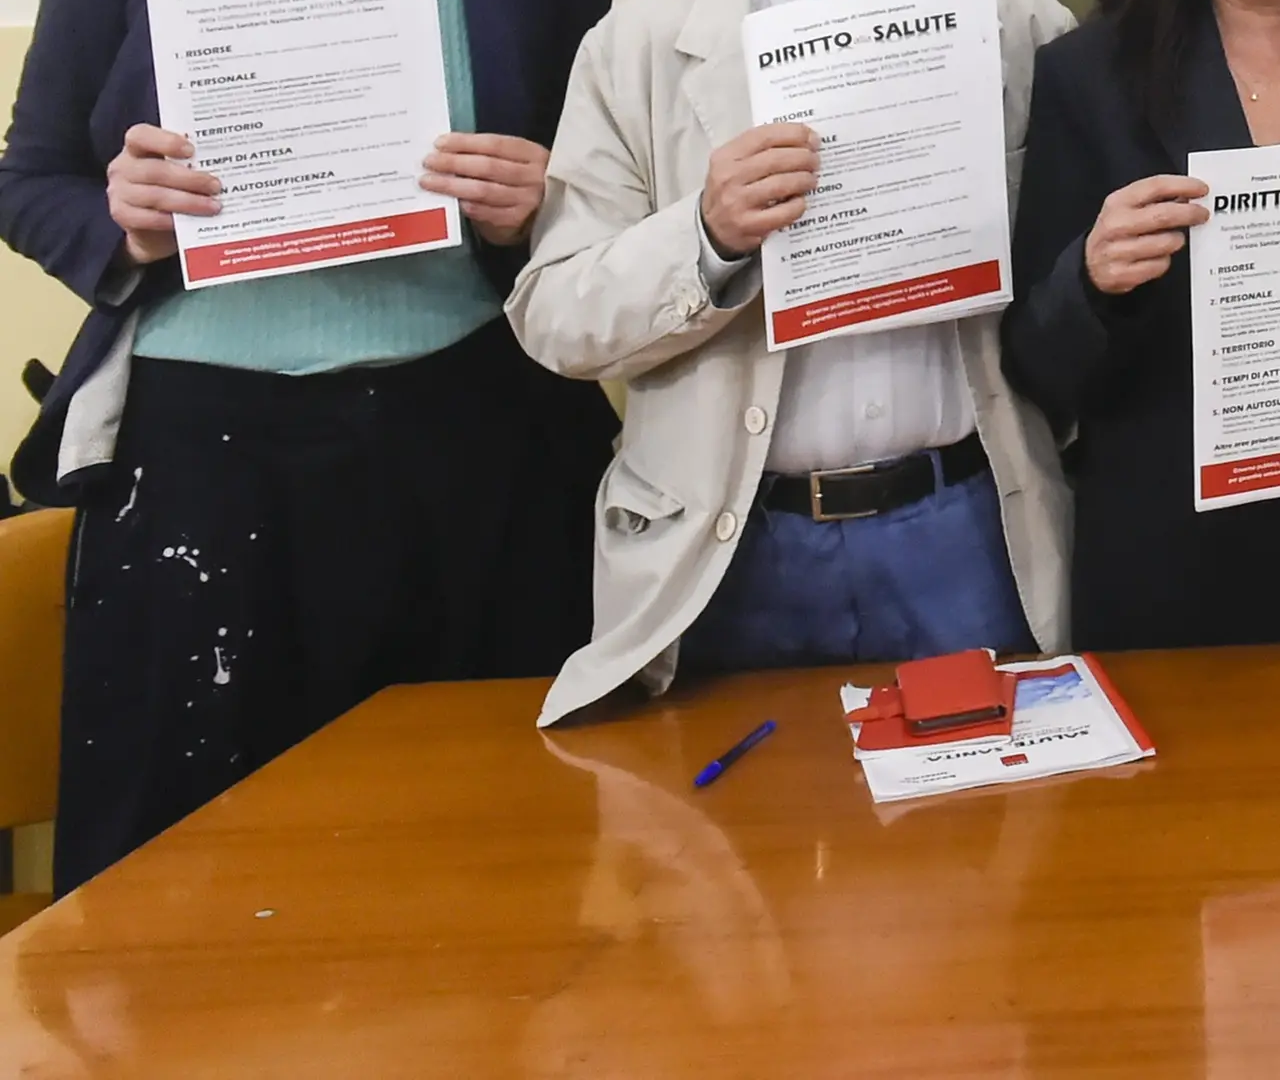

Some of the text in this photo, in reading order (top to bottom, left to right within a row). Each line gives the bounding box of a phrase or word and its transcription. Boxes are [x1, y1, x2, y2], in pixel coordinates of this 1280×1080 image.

[759, 12, 958, 69] DIRITTO SALUTE
[186, 45, 232, 58] RISORSE
[189, 72, 256, 88] PERSONALE
[194, 121, 264, 138] TERRITORIO
[199, 156, 232, 169] TEMPI
[236, 154, 247, 164] DI
[250, 148, 293, 162] ATTESA
[231, 170, 335, 192] AUTOSUFFICIENZA
[819, 213, 829, 223] DI
[831, 205, 868, 221] ATTESA
[790, 248, 813, 261] NON
[815, 227, 903, 255] AUTOSUFFICIENZA
[1218, 263, 1255, 275] RISORSE
[1219, 290, 1273, 305] PERSONALE
[1221, 340, 1275, 355] TERRITORIO
[1222, 373, 1249, 385] TEMPI
[1251, 371, 1260, 381] DI
[1222, 403, 1243, 415] NON
[1213, 442, 1232, 451] Altre
[1233, 439, 1249, 448] aree
